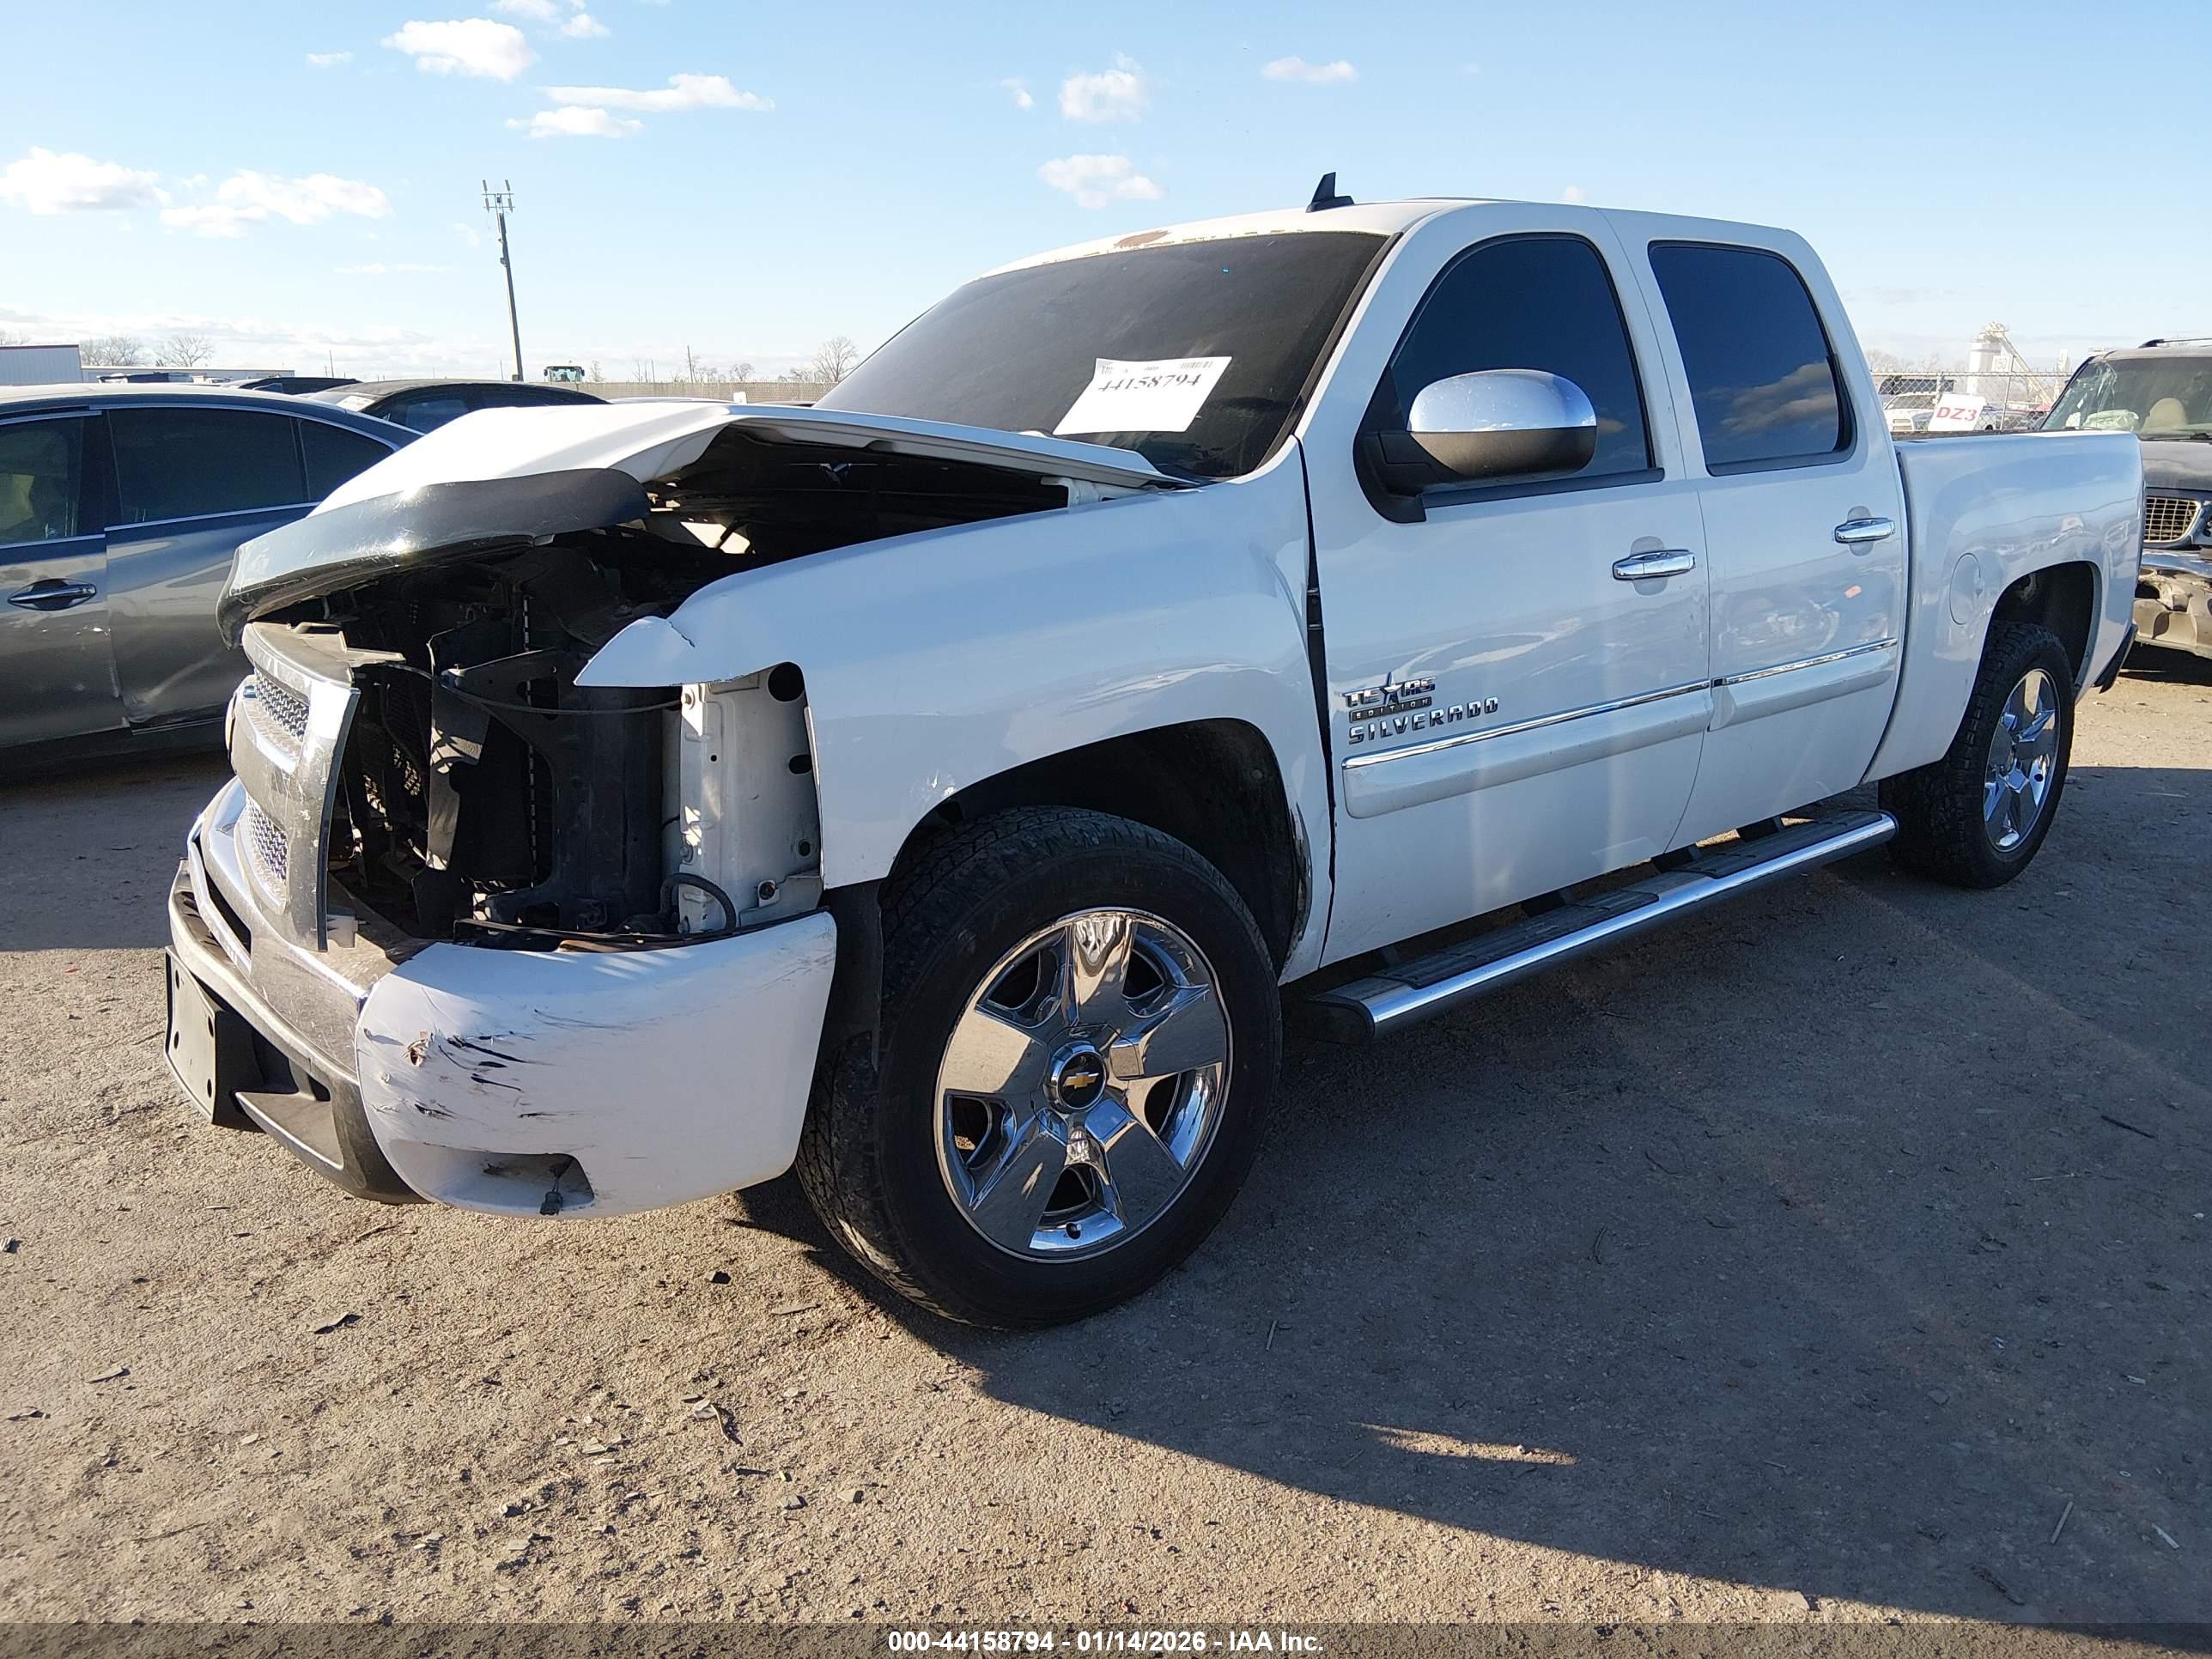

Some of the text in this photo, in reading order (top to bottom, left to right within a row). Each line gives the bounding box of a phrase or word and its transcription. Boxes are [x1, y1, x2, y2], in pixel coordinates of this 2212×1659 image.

[1098, 373, 1202, 392] 44158794
[1936, 406, 1978, 422] DZ3
[1341, 672, 1436, 708] TEXAS
[1348, 696, 1498, 744] SILVERADO
[1353, 697, 1431, 720] EDITION
